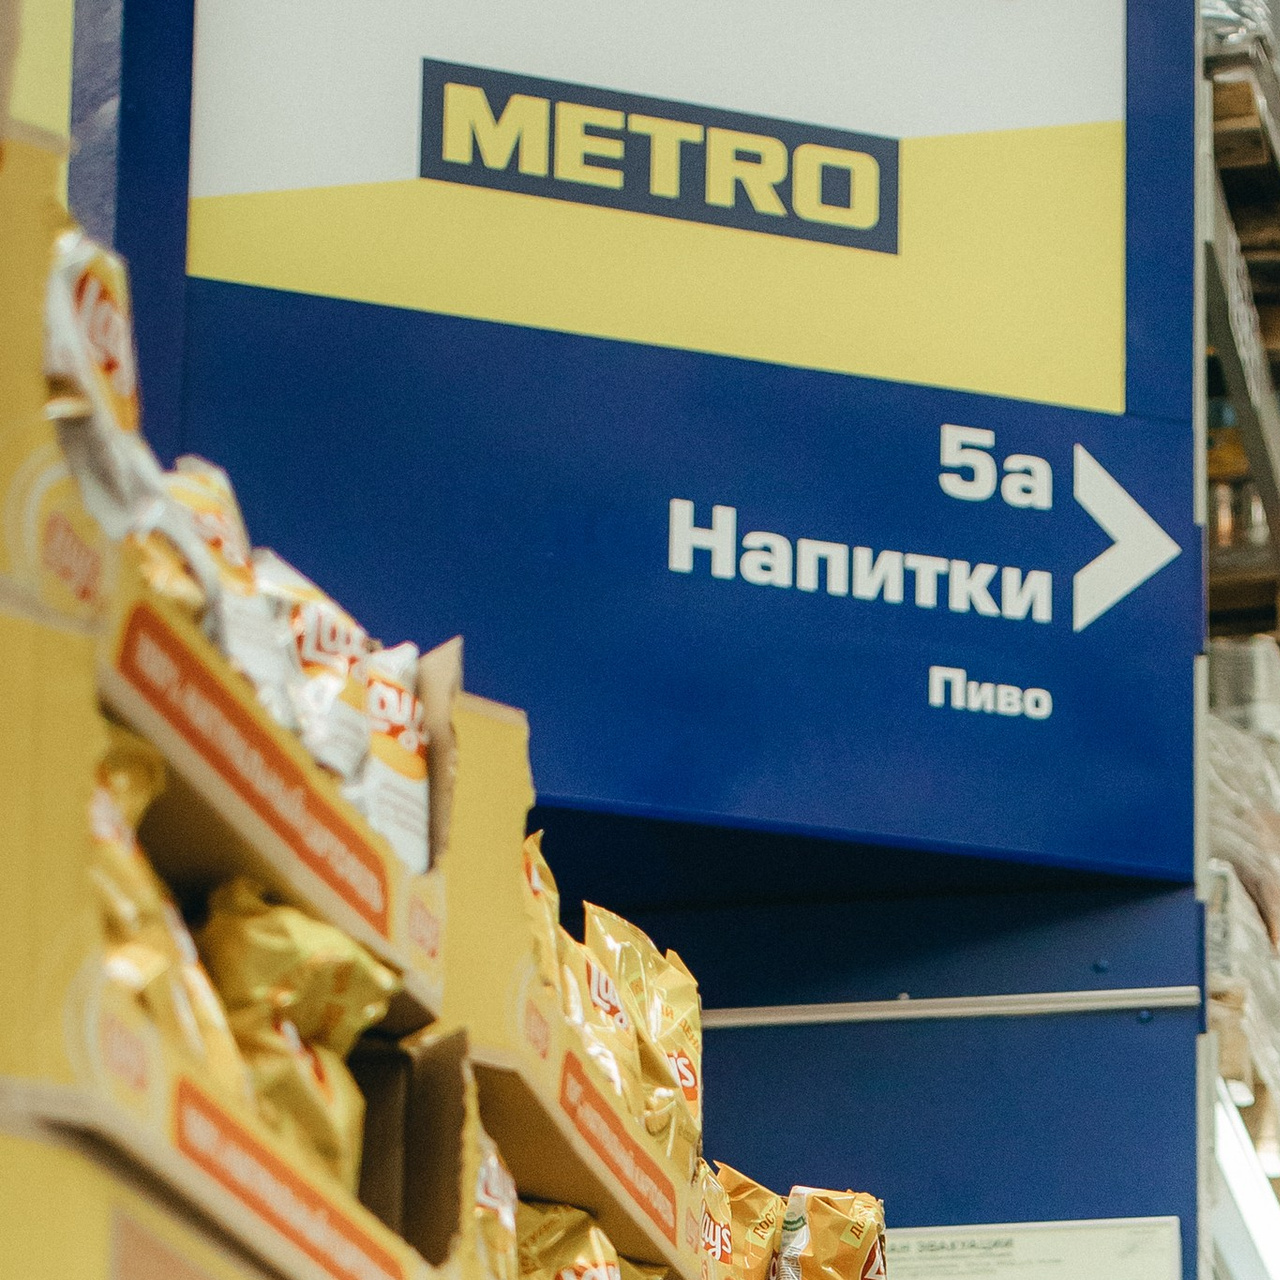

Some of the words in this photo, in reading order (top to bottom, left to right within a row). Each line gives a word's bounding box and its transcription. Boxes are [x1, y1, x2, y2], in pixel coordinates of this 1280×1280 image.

[441, 82, 881, 231] METRO
[939, 423, 1053, 511] 5а
[668, 498, 1053, 624] Напитки
[928, 664, 1053, 720] Пиво
[701, 1210, 732, 1261] ay's
